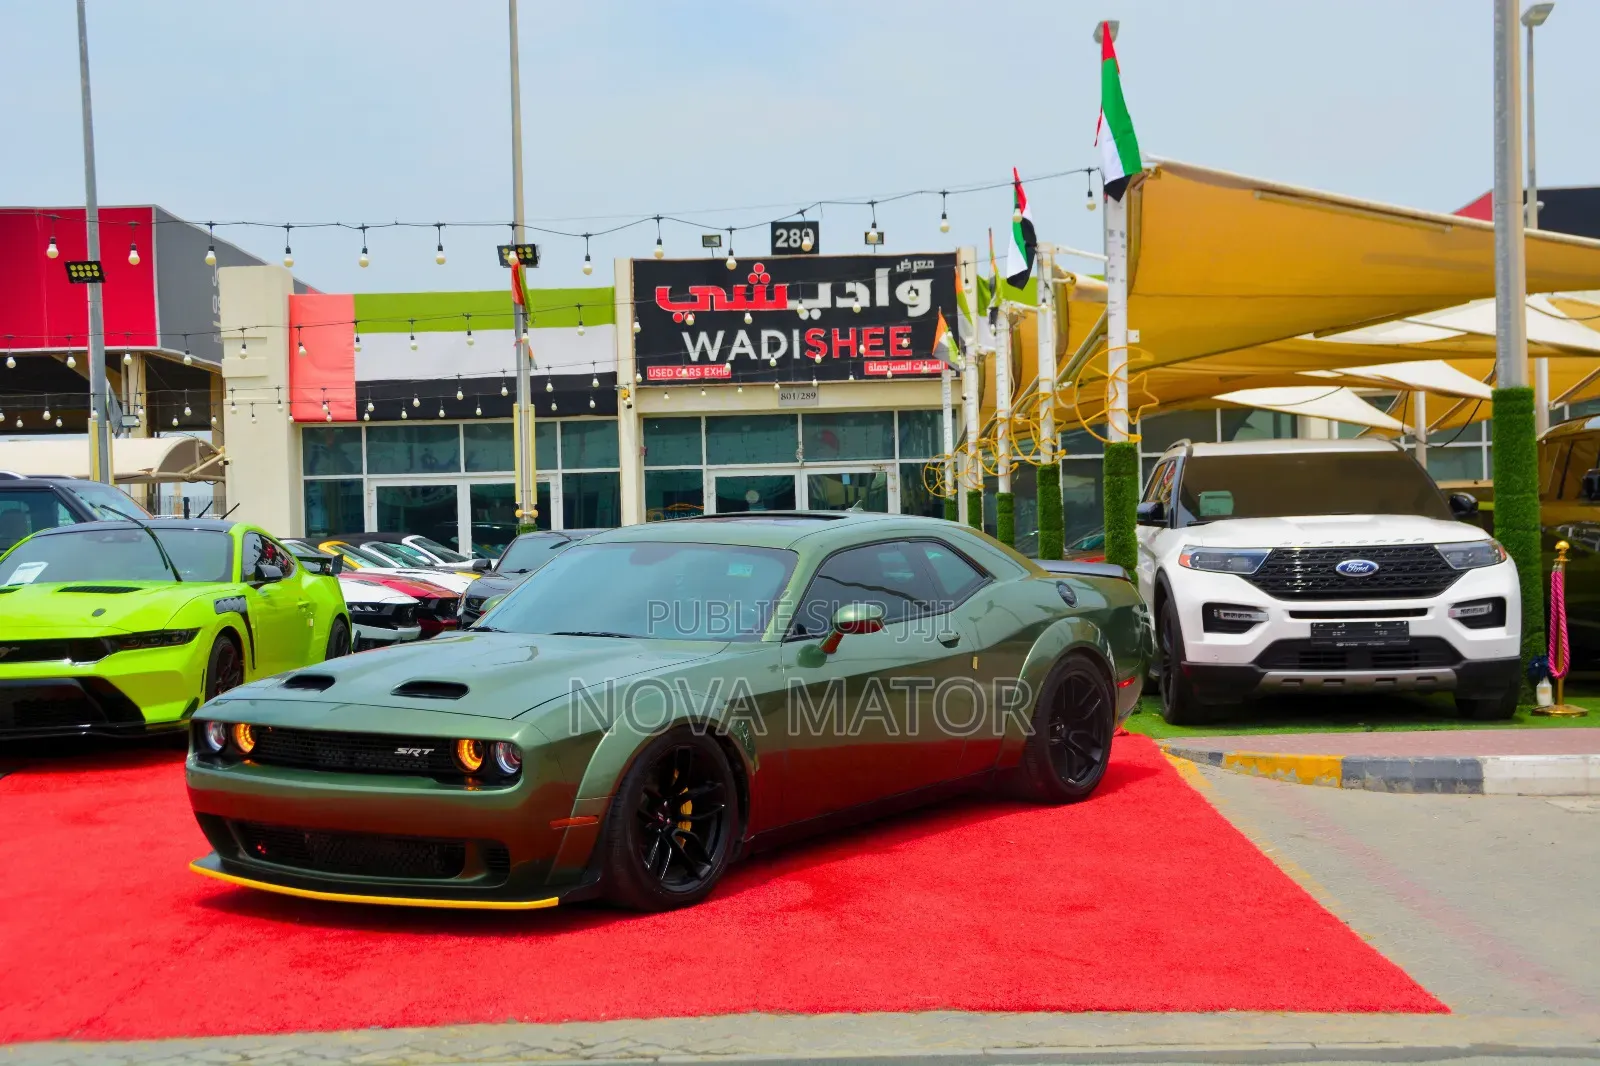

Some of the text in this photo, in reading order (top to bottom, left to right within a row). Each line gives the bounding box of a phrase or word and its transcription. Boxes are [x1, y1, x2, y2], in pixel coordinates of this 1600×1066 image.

[775, 228, 815, 248] 289
[896, 258, 935, 273] معرض
[649, 368, 674, 378] USED
[780, 391, 817, 401] 801/289
[394, 747, 435, 757] SRT
